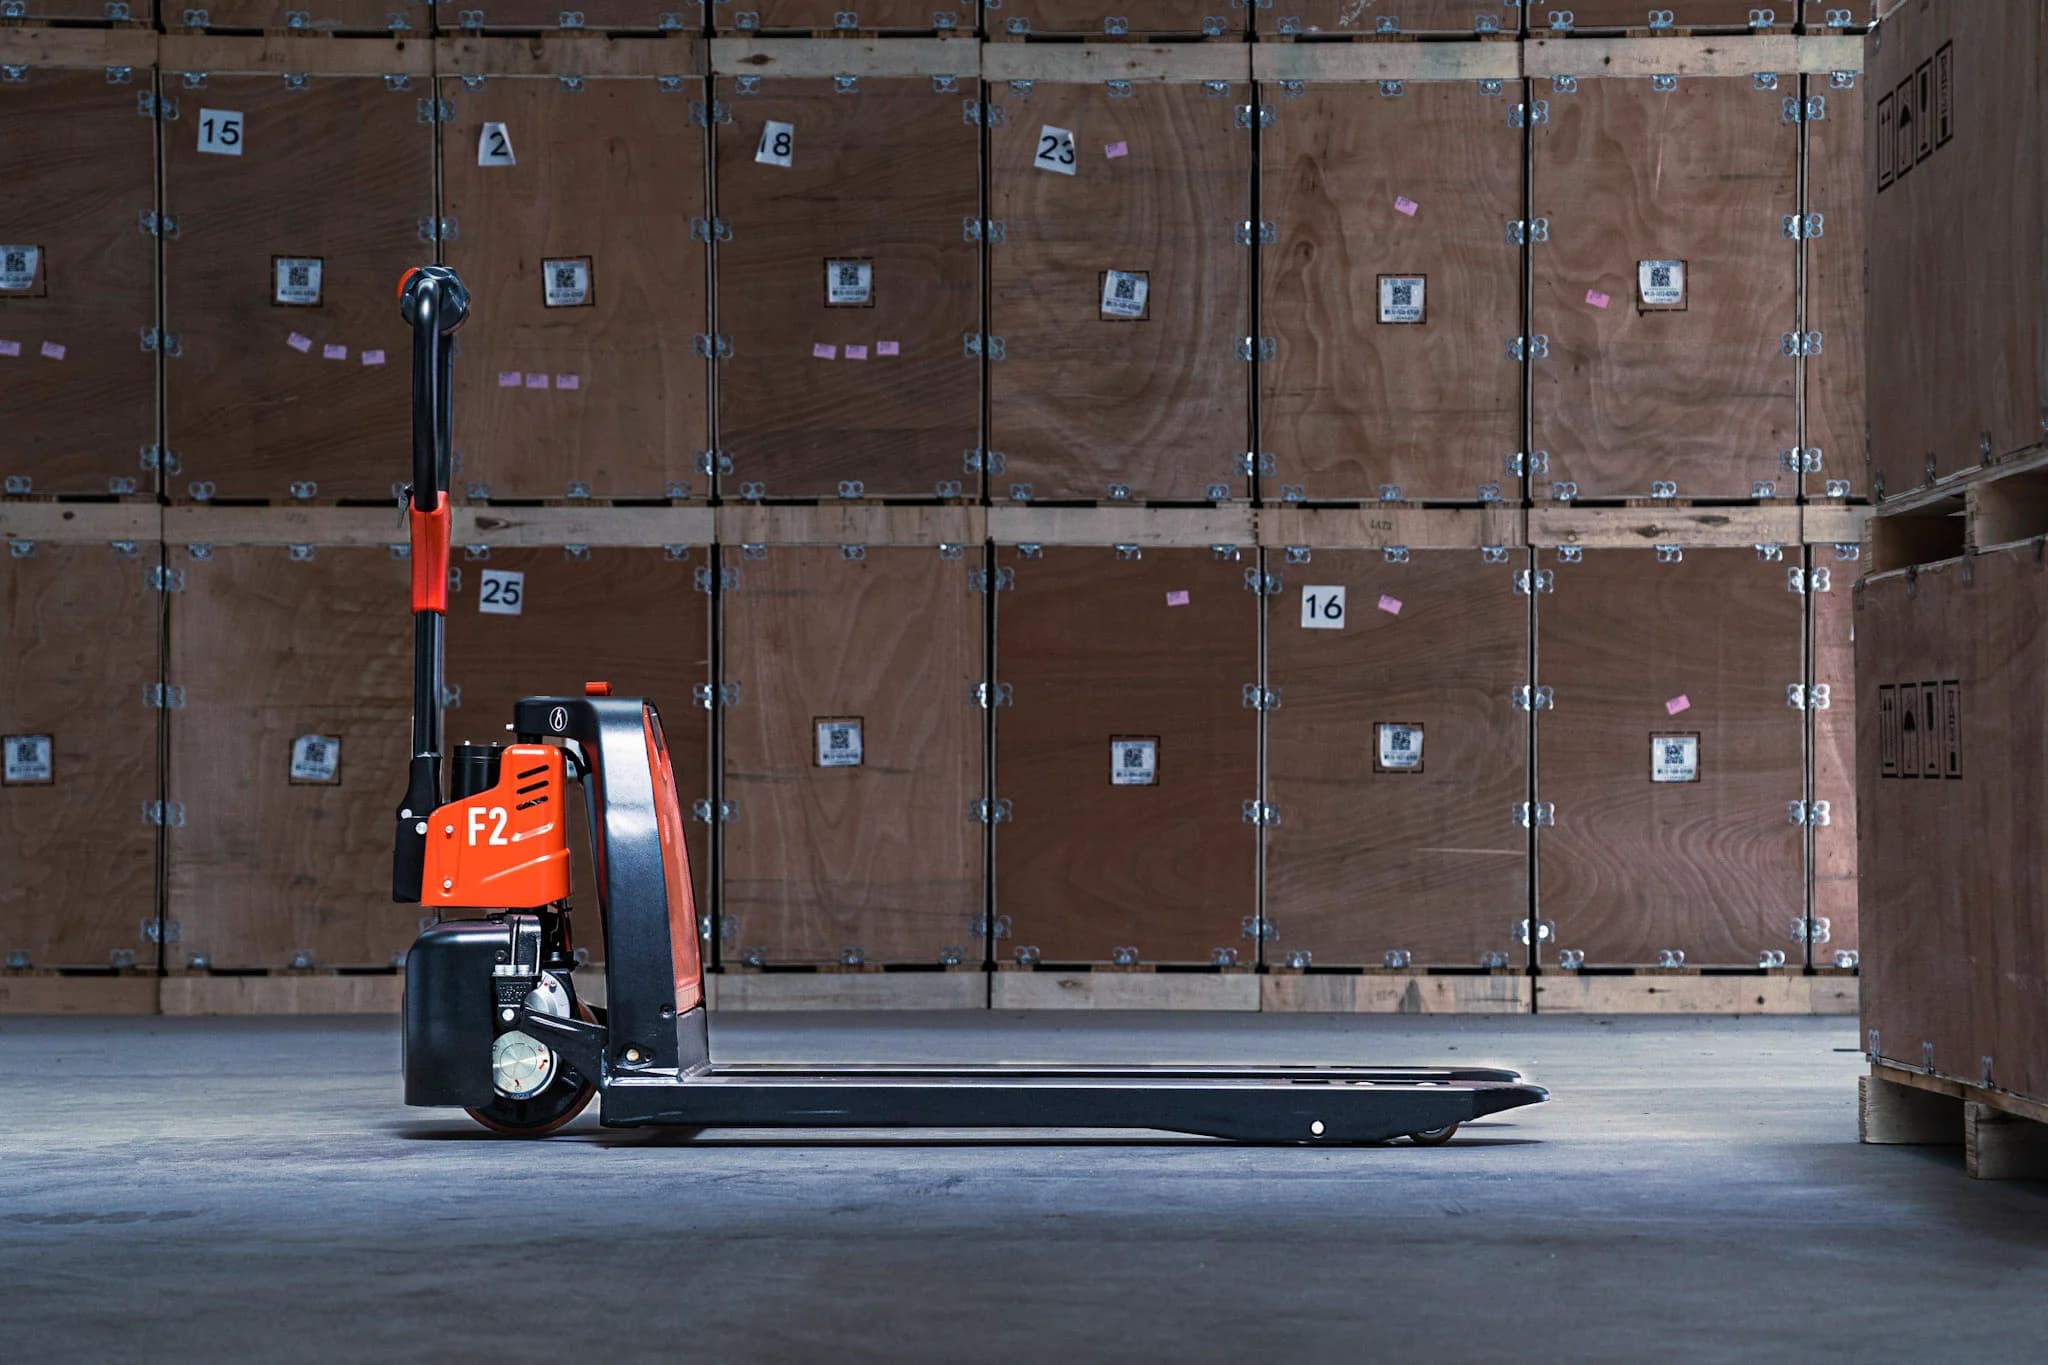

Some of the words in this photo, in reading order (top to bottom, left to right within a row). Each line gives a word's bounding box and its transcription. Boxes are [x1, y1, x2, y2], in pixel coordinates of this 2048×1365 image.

[203, 118, 239, 145] 15
[1038, 135, 1076, 165] 23
[482, 579, 520, 605] 25
[1305, 594, 1343, 620] 16
[467, 806, 509, 847] F2
